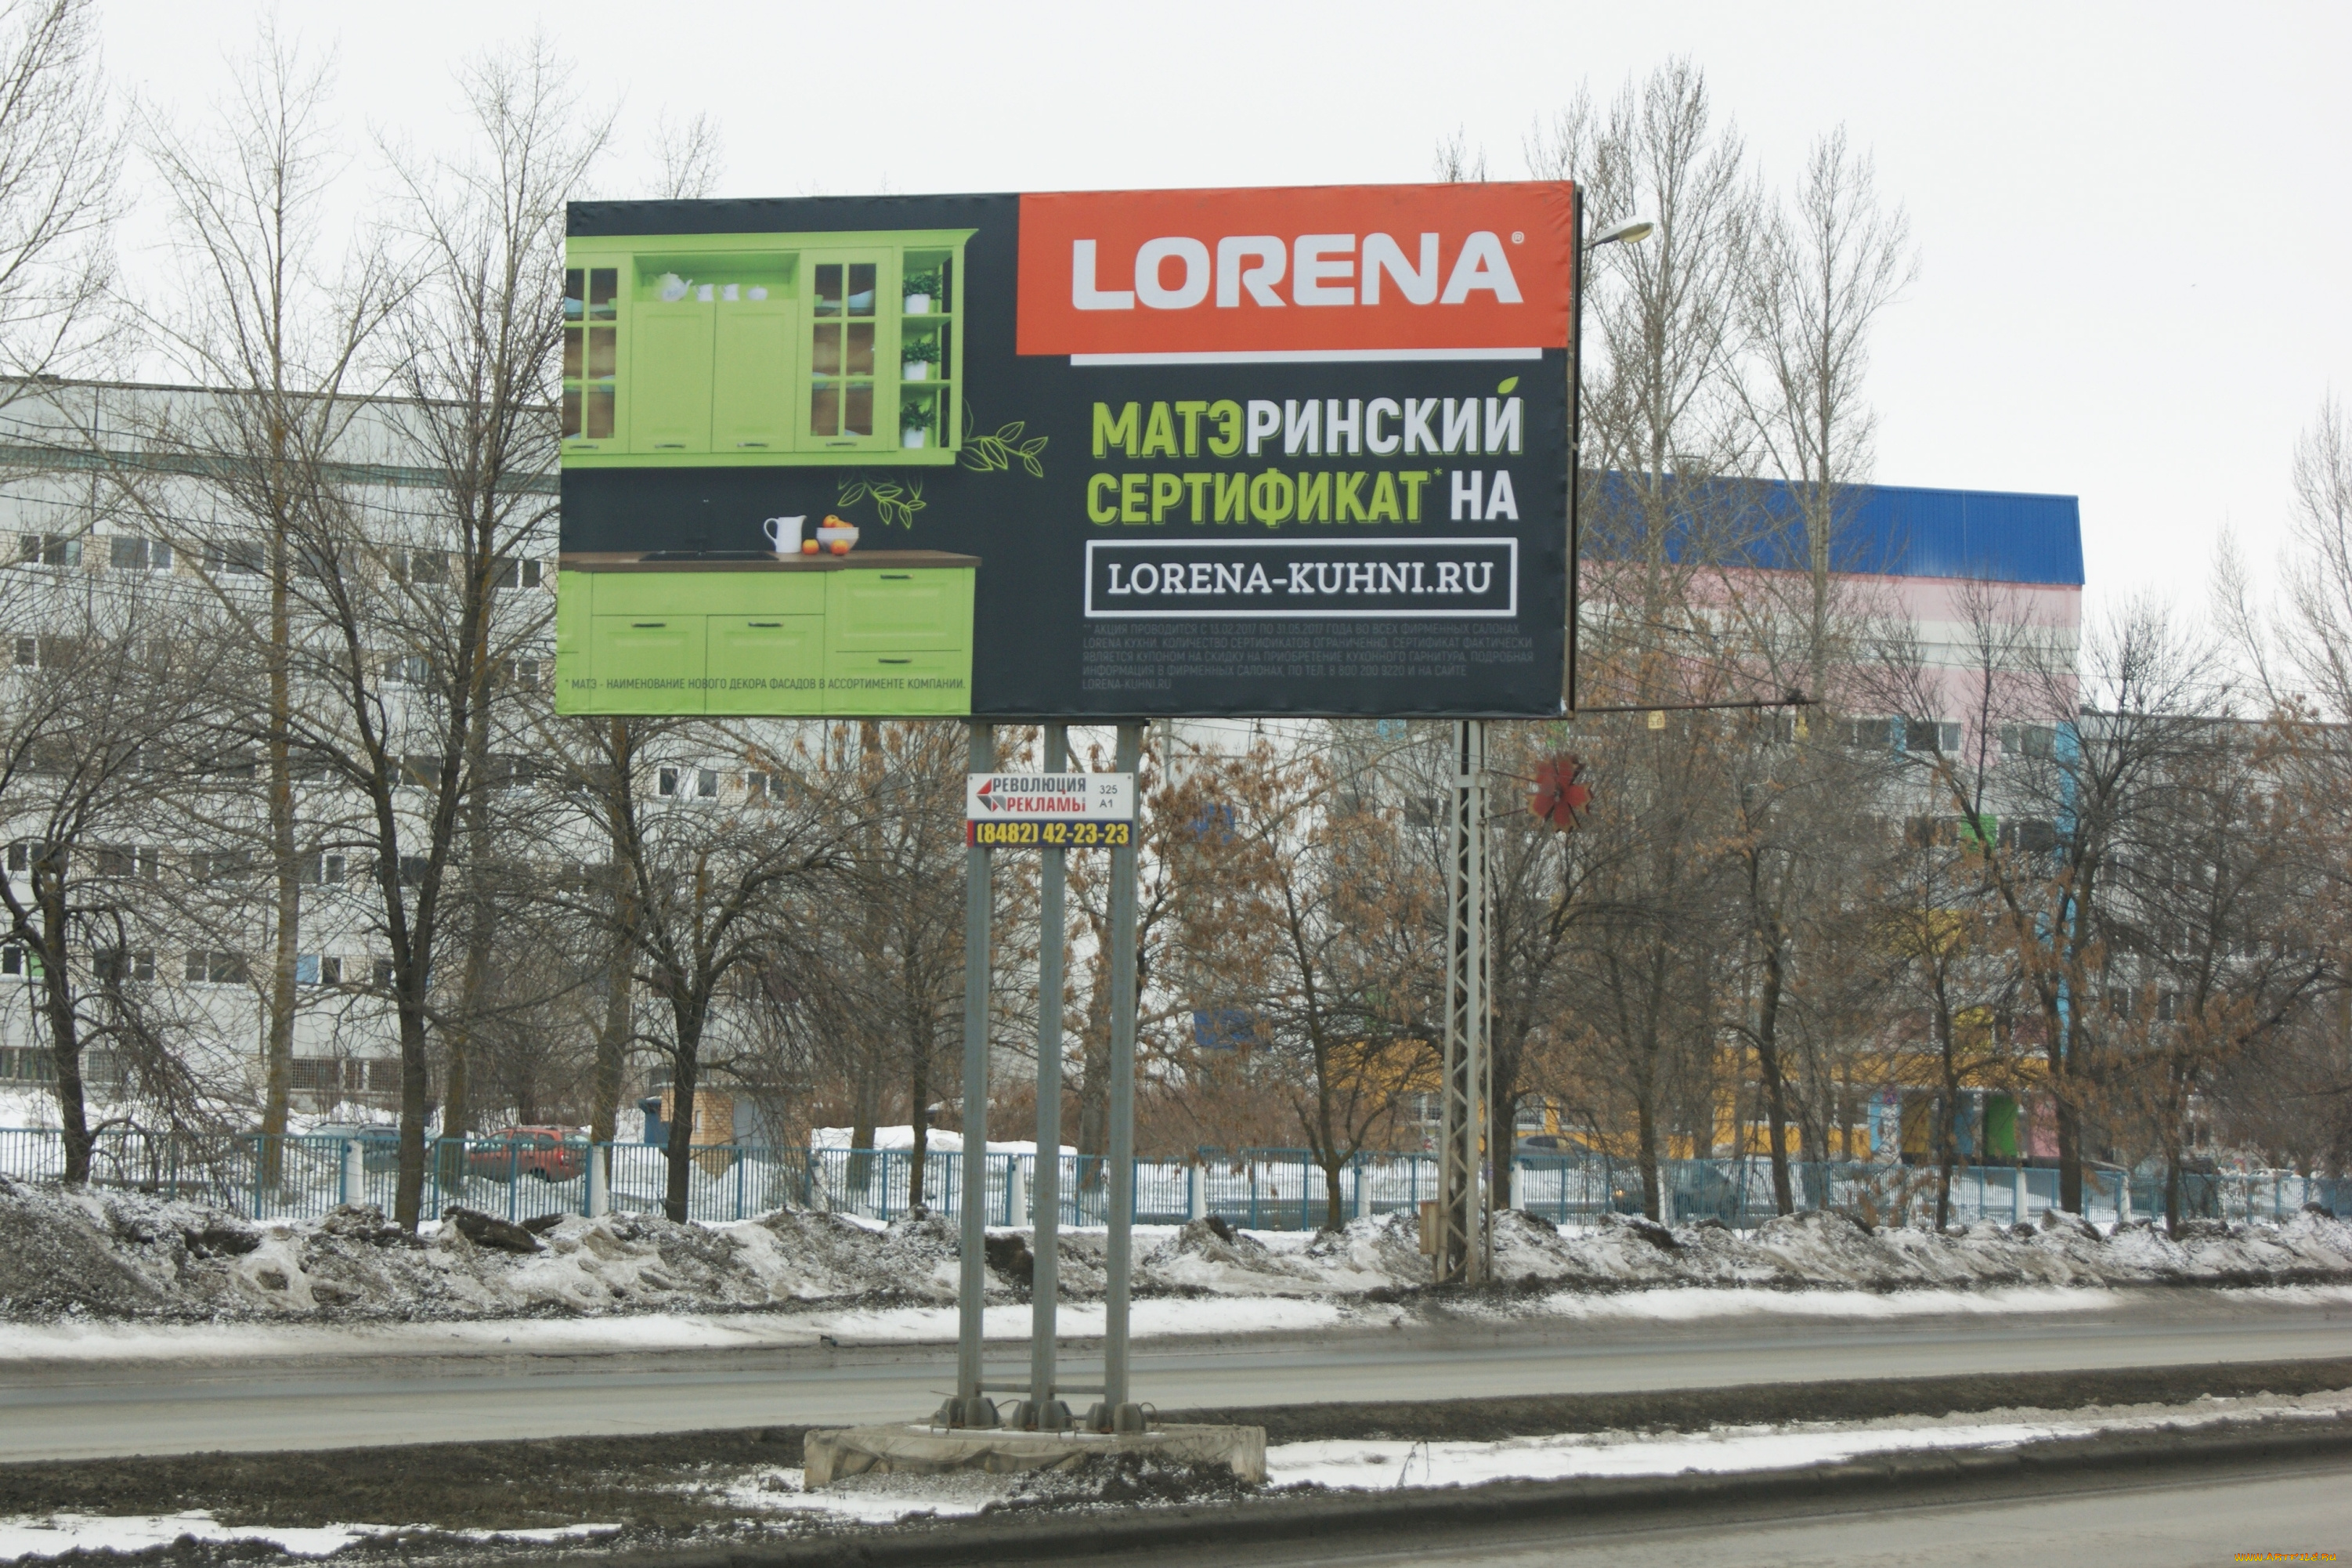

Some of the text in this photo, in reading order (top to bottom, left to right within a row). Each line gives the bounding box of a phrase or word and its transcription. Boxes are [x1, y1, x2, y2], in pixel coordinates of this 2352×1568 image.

[1093, 376, 1523, 458] МАТЭРИНСКИЙ
[1451, 470, 1519, 521] НА
[1108, 562, 1494, 594] LORENA-KUHNI.RU
[1094, 623, 1128, 634] АКЦИЯ
[1131, 623, 1198, 634] ПРОВОДИТСЯ
[1200, 623, 1207, 634] С
[1210, 623, 1256, 634] 13.02.2017
[1259, 623, 1274, 634] ПО
[1277, 623, 1323, 634] 31.05.2017
[1327, 623, 1353, 634] ГОДА
[1356, 623, 1369, 634] ВО
[1372, 623, 1398, 634] ВСЕХ
[1400, 623, 1469, 634] ФИРМЕННЫХ
[1472, 623, 1519, 634] САЛОНАХ
[1083, 638, 1122, 649] LORENA
[1162, 638, 1227, 649] КОЛИЧЕСТВО
[1230, 638, 1310, 649] СЕРТИФИКАТОВ
[1393, 638, 1460, 649] СЕРТИФИКАТ
[1462, 638, 1533, 649] ФАКТИЧЕСКИ
[1082, 651, 1133, 662] ЯВЛЯЕТСЯ
[1136, 651, 1185, 662] КУПОНОМ
[1188, 651, 1201, 662] НА
[1205, 651, 1244, 663] СКИДКУ
[1248, 651, 1260, 662] НА
[1264, 651, 1342, 662] ПРИОБРЕТЕНИЕ
[1346, 651, 1406, 662] КУХОННОГО
[1471, 651, 1534, 663] ПОДРОБНАЯ
[1082, 665, 1154, 676] ИНФОРМАЦИЯ
[1158, 665, 1164, 676] В
[1167, 665, 1234, 676] ФИРМЕННЫХ
[1288, 665, 1302, 676] ПО
[1306, 665, 1326, 676] ТЕЛ.
[1329, 665, 1335, 676] 8
[1339, 665, 1357, 676] 800
[1360, 665, 1378, 676] 200
[1382, 665, 1404, 676] 9220
[1408, 665, 1414, 676] И
[1418, 665, 1432, 676] НА
[1435, 663, 1466, 676] САЙТЕ
[572, 678, 597, 689] МАТЭ
[606, 678, 685, 689] НАИМЕНОВАНИЕ
[688, 678, 727, 689] НОВОГО
[729, 678, 767, 690] ДЕКОРА
[769, 678, 815, 689] ФАСАДОВ
[819, 678, 826, 689] В
[828, 678, 905, 689] АССОРТИМЕНТЕ
[908, 678, 966, 689] КОМПАНИИ.
[1082, 678, 1172, 689] LORENA-KUHNI.RU
[992, 777, 1086, 795] РЕВОЛЮЦИЯ
[1100, 785, 1118, 794] 325
[1006, 797, 1086, 812] РЕКЛАМЫ
[977, 823, 1129, 844] (8482) 42-23-23
